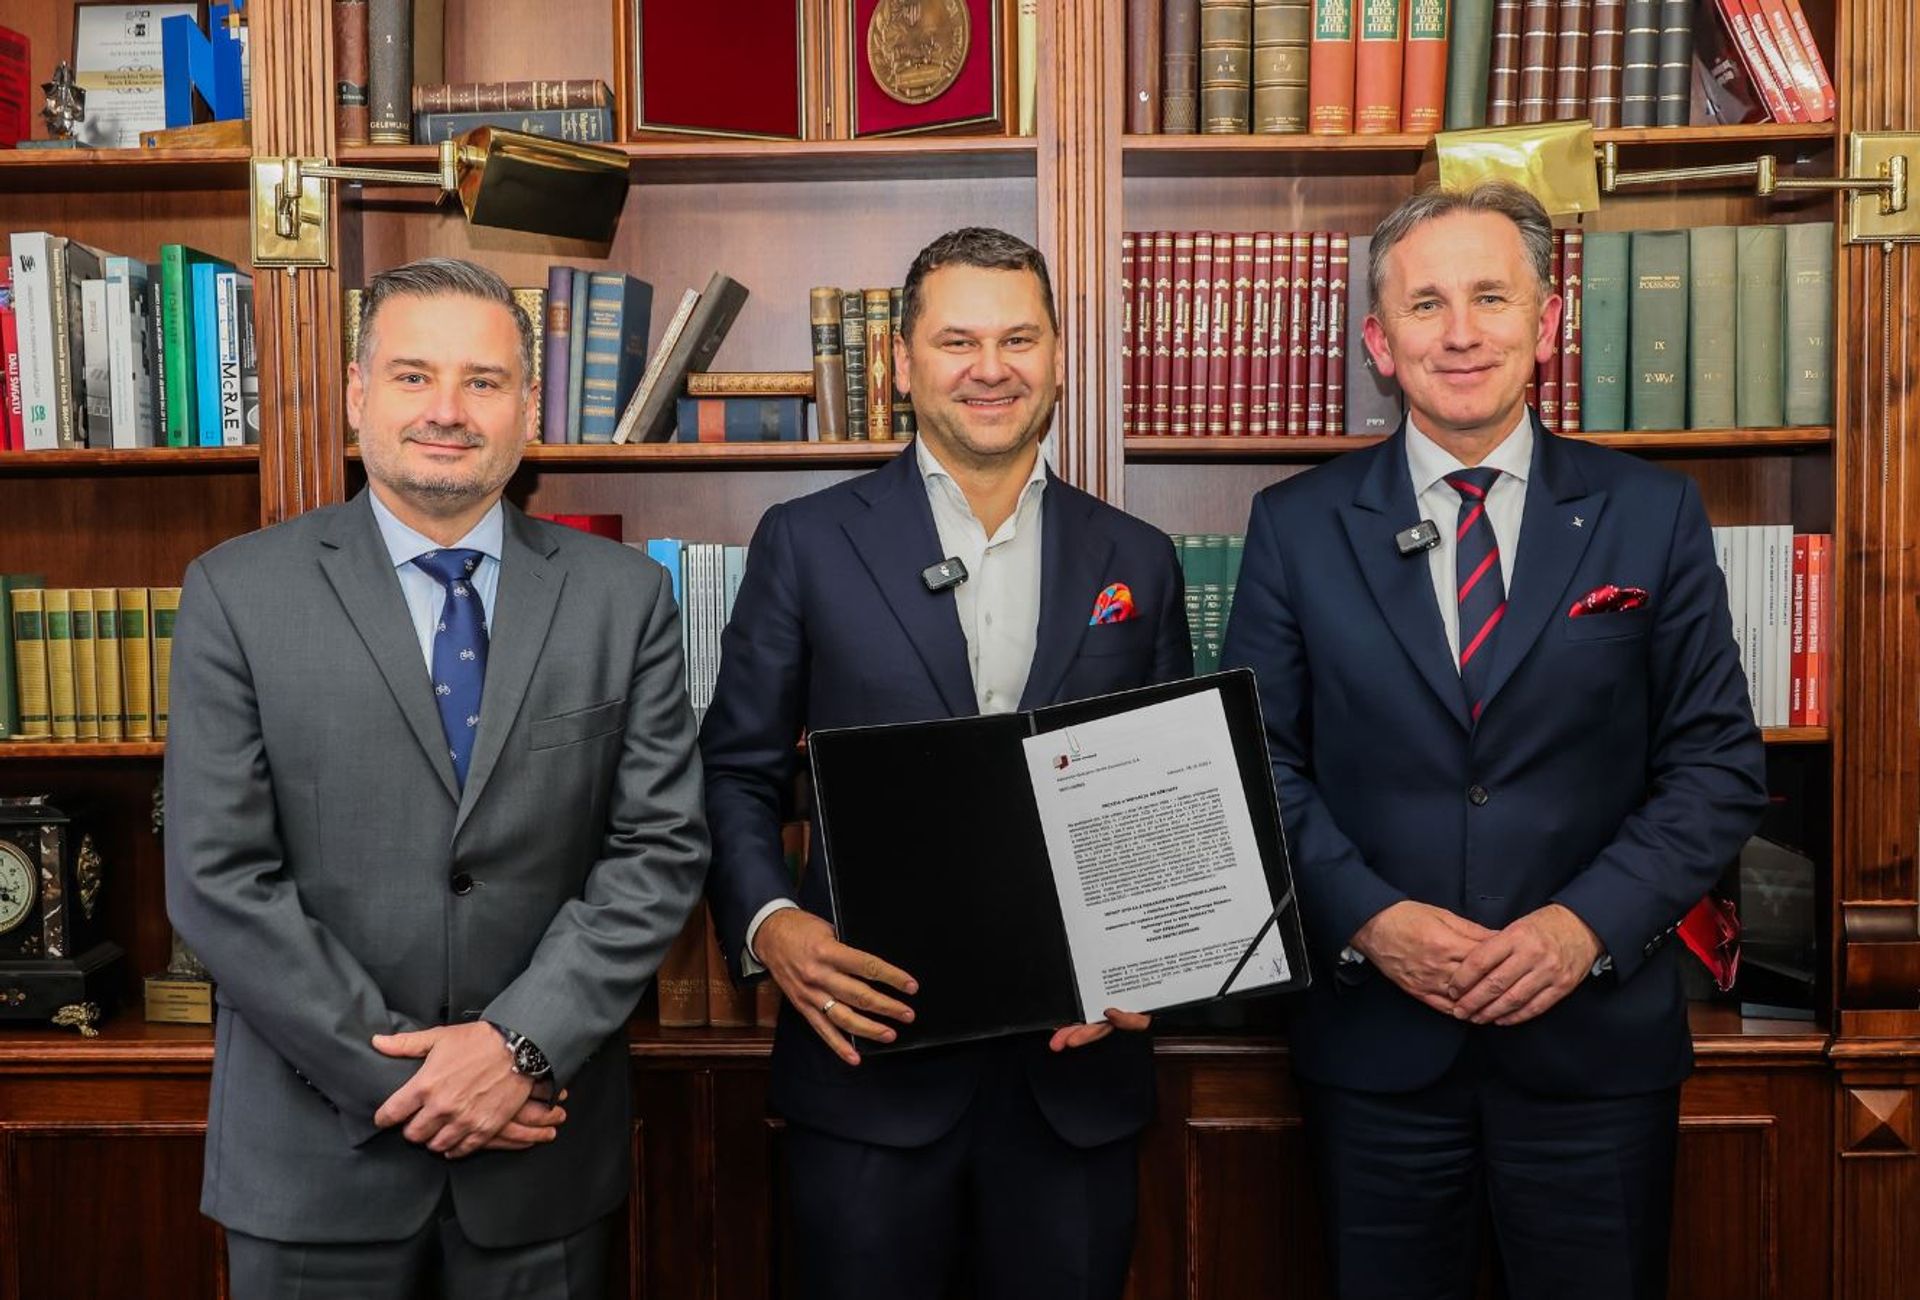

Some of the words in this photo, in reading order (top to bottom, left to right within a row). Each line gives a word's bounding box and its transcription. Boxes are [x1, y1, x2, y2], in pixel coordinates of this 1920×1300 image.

[1367, 7, 1395, 16] REICH
[1372, 15, 1391, 23] DER
[1367, 24, 1395, 32] TIERE
[1655, 341, 1665, 350] IX
[222, 362, 240, 430] McRAE
